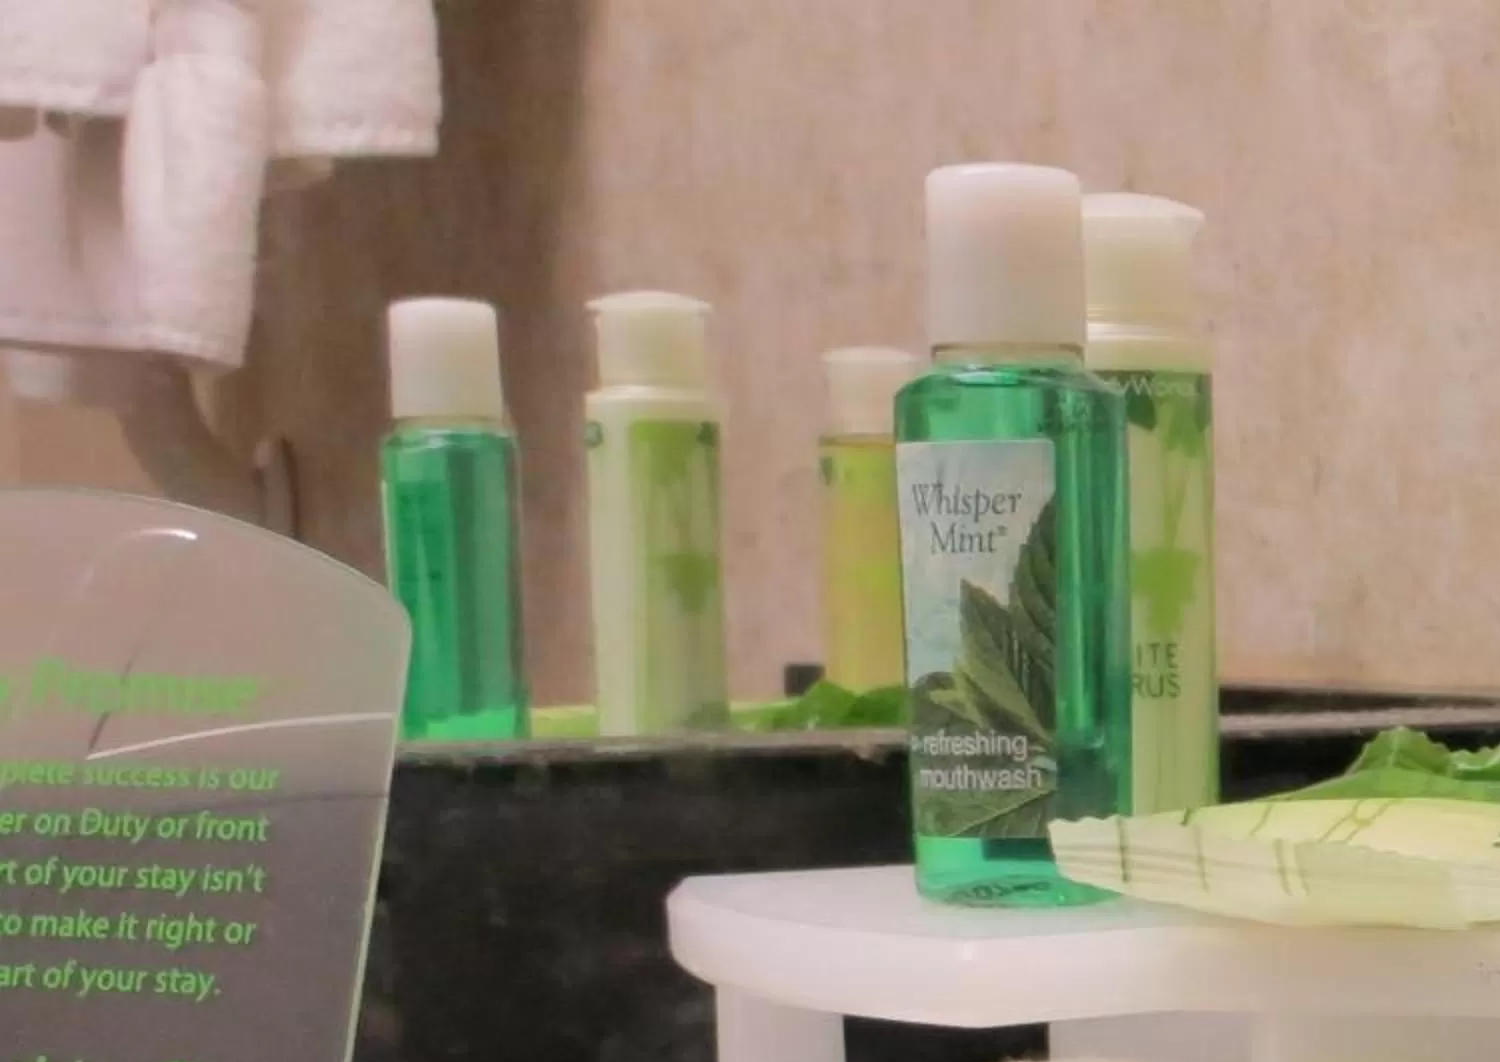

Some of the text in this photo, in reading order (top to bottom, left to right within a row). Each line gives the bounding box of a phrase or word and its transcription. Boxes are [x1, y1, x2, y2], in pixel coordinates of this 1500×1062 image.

[911, 483, 1022, 523] Whisper
[922, 729, 1029, 761] refreshing
[84, 765, 191, 788] success
[200, 767, 219, 790] is
[228, 767, 280, 791] our
[920, 765, 1042, 791] mouthwash
[34, 812, 71, 835] on
[80, 808, 150, 844] Duty
[157, 816, 187, 838] or
[196, 810, 270, 842] front
[24, 856, 59, 885] of
[63, 865, 129, 893] your
[135, 863, 196, 896] stay
[201, 863, 265, 893] isn't
[30, 909, 108, 938] make
[117, 911, 139, 938] it
[145, 912, 214, 949] right
[223, 920, 256, 945] or
[43, 961, 77, 989] of
[79, 970, 147, 996] your
[155, 969, 222, 1002] stay.
